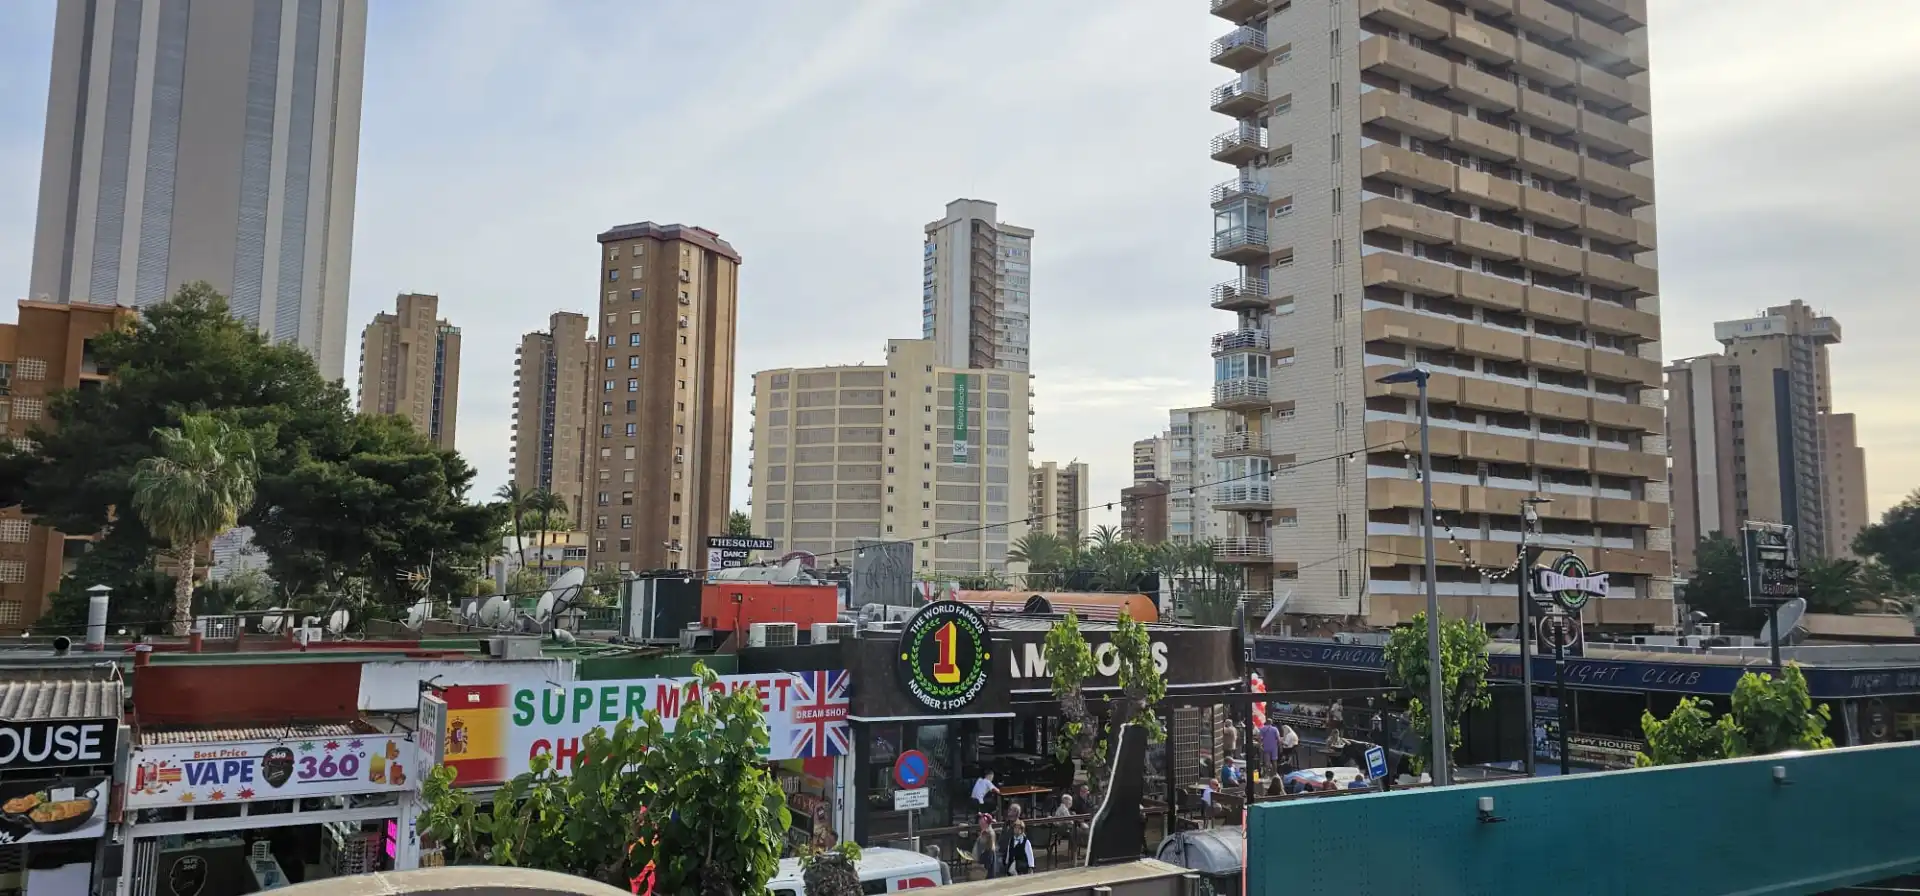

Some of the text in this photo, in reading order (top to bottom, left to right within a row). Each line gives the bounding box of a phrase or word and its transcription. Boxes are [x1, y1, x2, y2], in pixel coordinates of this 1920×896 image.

[723, 550, 748, 558] DANCE
[910, 604, 985, 634] THE WORLD FAMOUS
[934, 620, 960, 684] 1
[1641, 668, 1701, 685] CLUB
[908, 671, 988, 710] NUMBER 1 FOR SPORT
[512, 678, 792, 727] SUPER MAET
[795, 707, 847, 718] DREAM SHOP
[193, 749, 247, 759] Best Price
[1567, 736, 1596, 746] APPY
[1598, 740, 1641, 751] HOURS
[184, 759, 254, 786] VAPE
